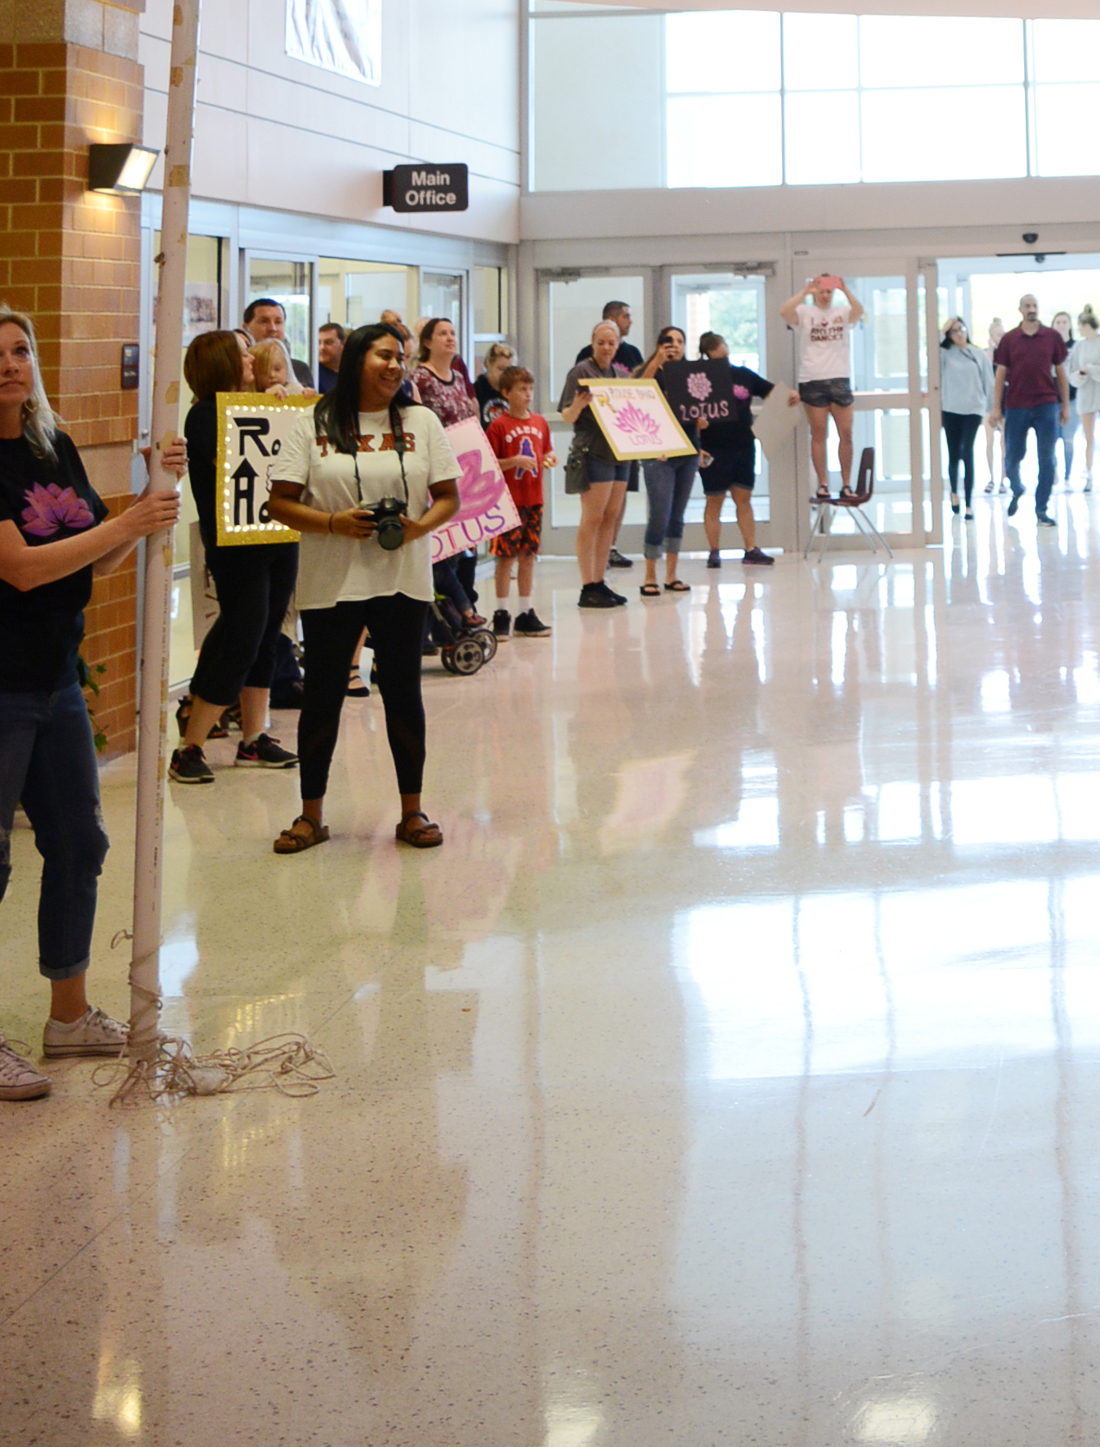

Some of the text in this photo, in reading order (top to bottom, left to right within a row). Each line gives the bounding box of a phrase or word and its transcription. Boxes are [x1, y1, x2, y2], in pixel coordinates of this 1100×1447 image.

[411, 171, 451, 186] Main
[405, 189, 457, 206] Office
[316, 432, 415, 458] TXAS
[432, 504, 506, 558] OTUS
